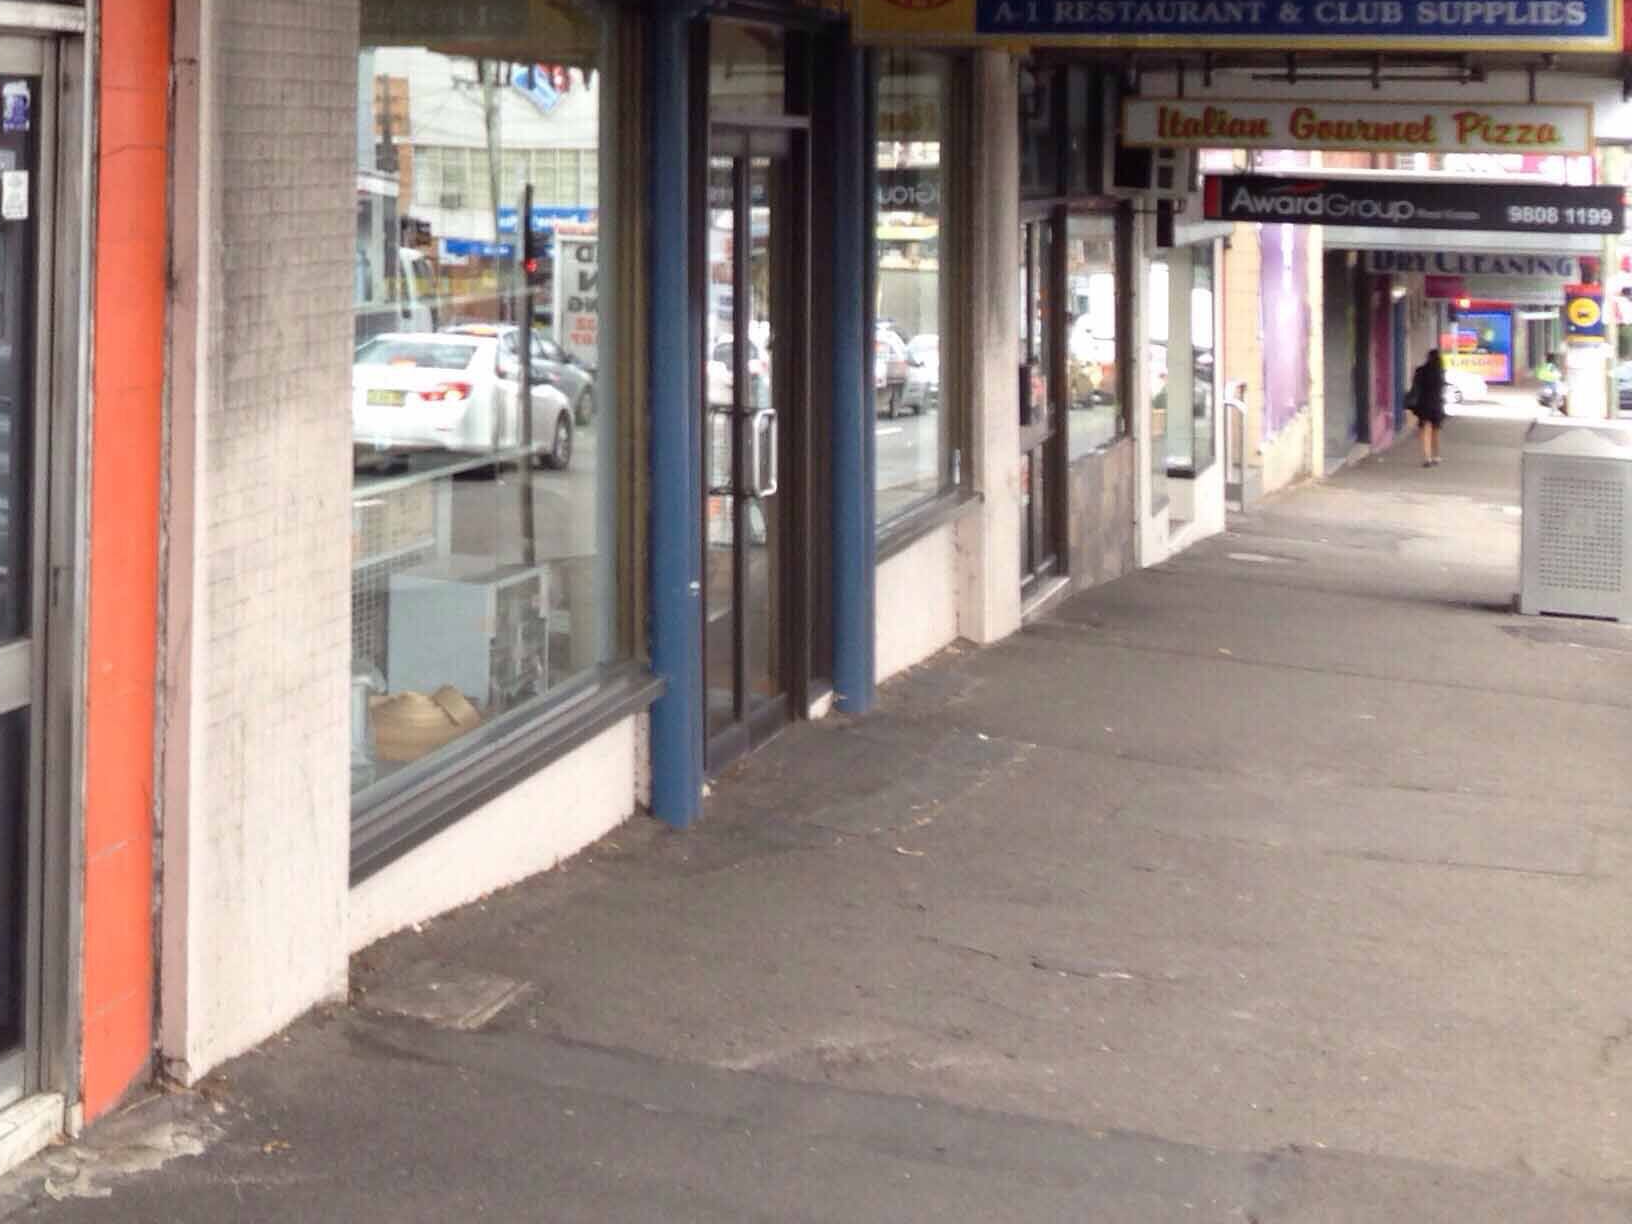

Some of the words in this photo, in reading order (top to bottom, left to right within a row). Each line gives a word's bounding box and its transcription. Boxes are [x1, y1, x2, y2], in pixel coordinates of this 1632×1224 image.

[1053, 0, 1265, 25] RESTAURANT
[1278, 0, 1302, 24] &
[1314, 0, 1404, 25] CLUB
[1416, 0, 1587, 26] SUPPLIES
[1156, 105, 1272, 139] Italian
[1289, 107, 1435, 144] Gourmet
[1451, 110, 1561, 146] Pizza
[1506, 205, 1559, 225] 9808
[1565, 207, 1614, 226] 1199
